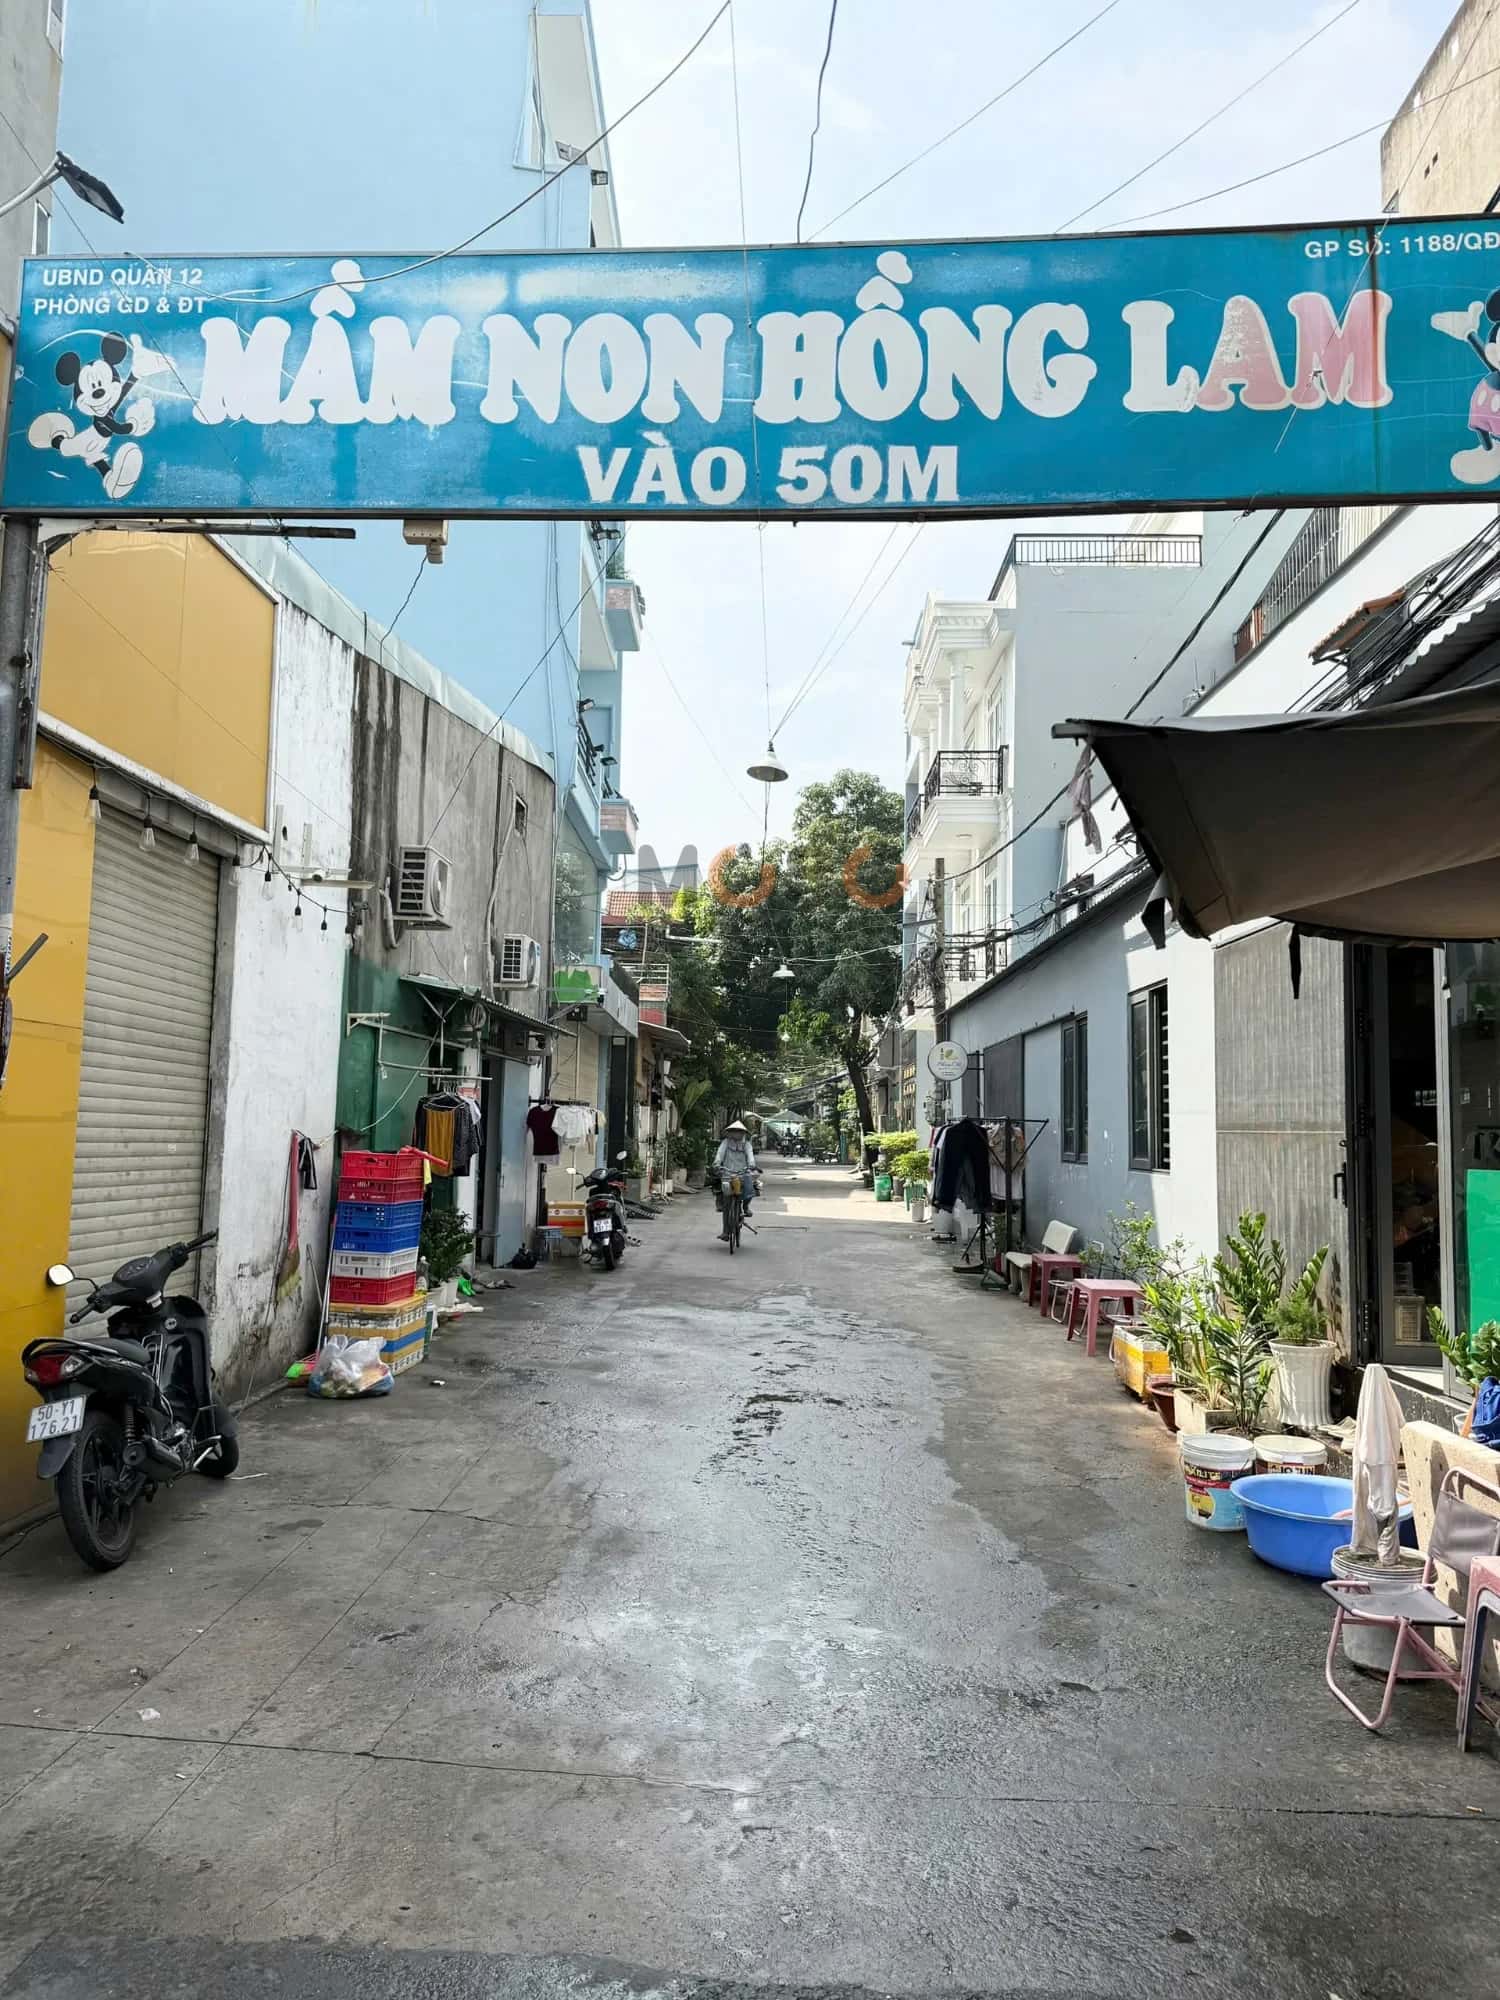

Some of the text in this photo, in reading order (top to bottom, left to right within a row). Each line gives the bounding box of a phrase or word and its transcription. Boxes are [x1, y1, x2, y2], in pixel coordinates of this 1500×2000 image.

[1304, 240, 1340, 258] GP
[43, 268, 104, 287] UBND
[180, 268, 203, 285] 12
[33, 294, 208, 315] PHÒNG GD & ĐT
[192, 250, 1393, 425] MẦM NON HỒNG LAM
[577, 429, 961, 505] VÀO 50M
[31, 1415, 77, 1440] 176.21
